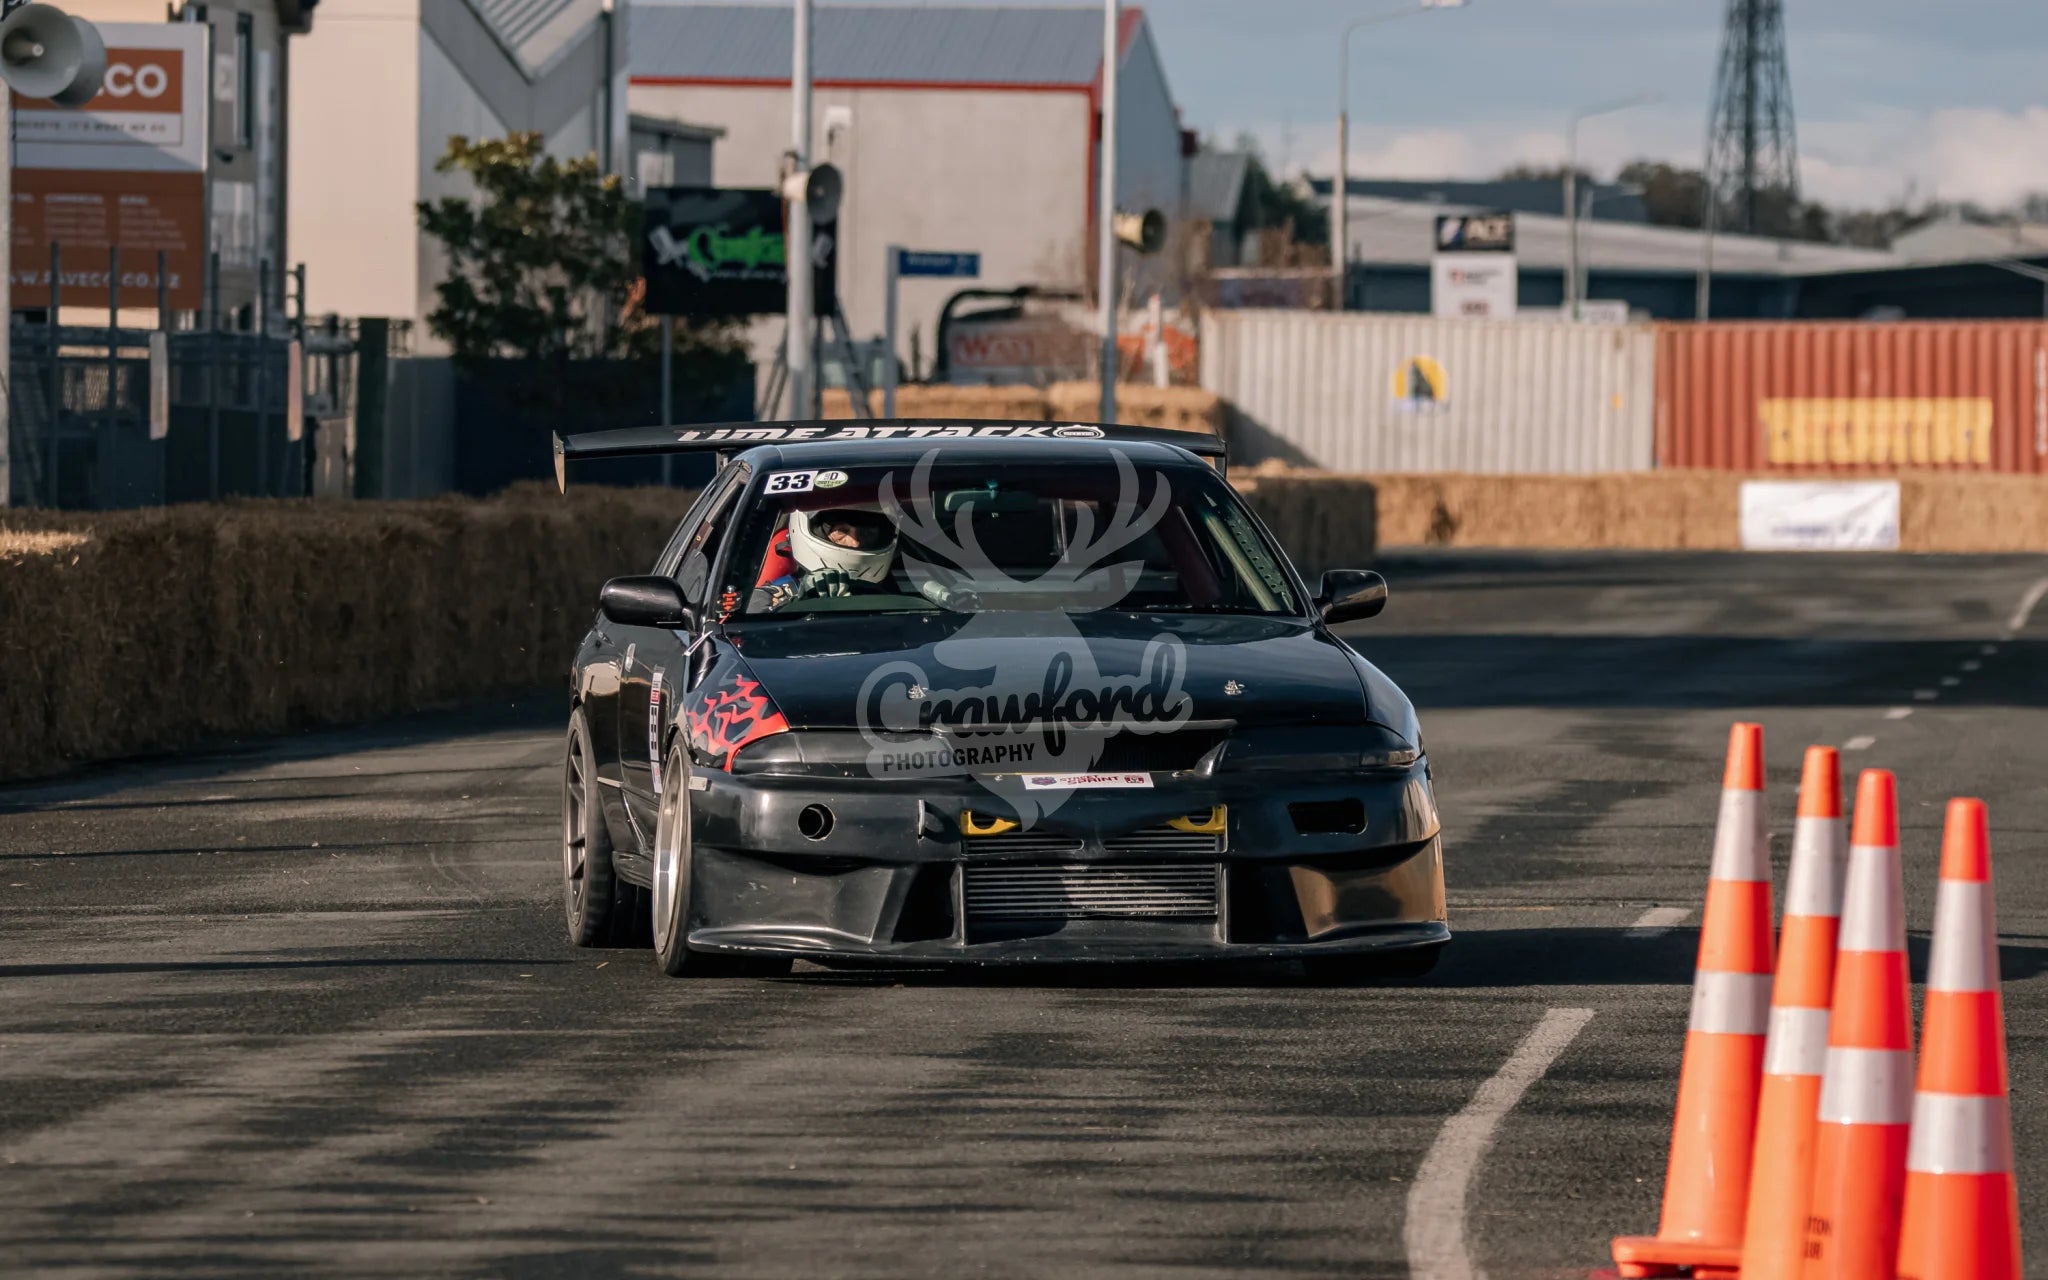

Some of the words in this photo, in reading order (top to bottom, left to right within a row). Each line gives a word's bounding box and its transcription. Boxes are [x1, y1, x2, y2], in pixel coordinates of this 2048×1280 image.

[97, 63, 168, 97] CO
[676, 427, 826, 442] TIME
[823, 426, 1053, 439] ATTACK
[771, 473, 811, 491] 33
